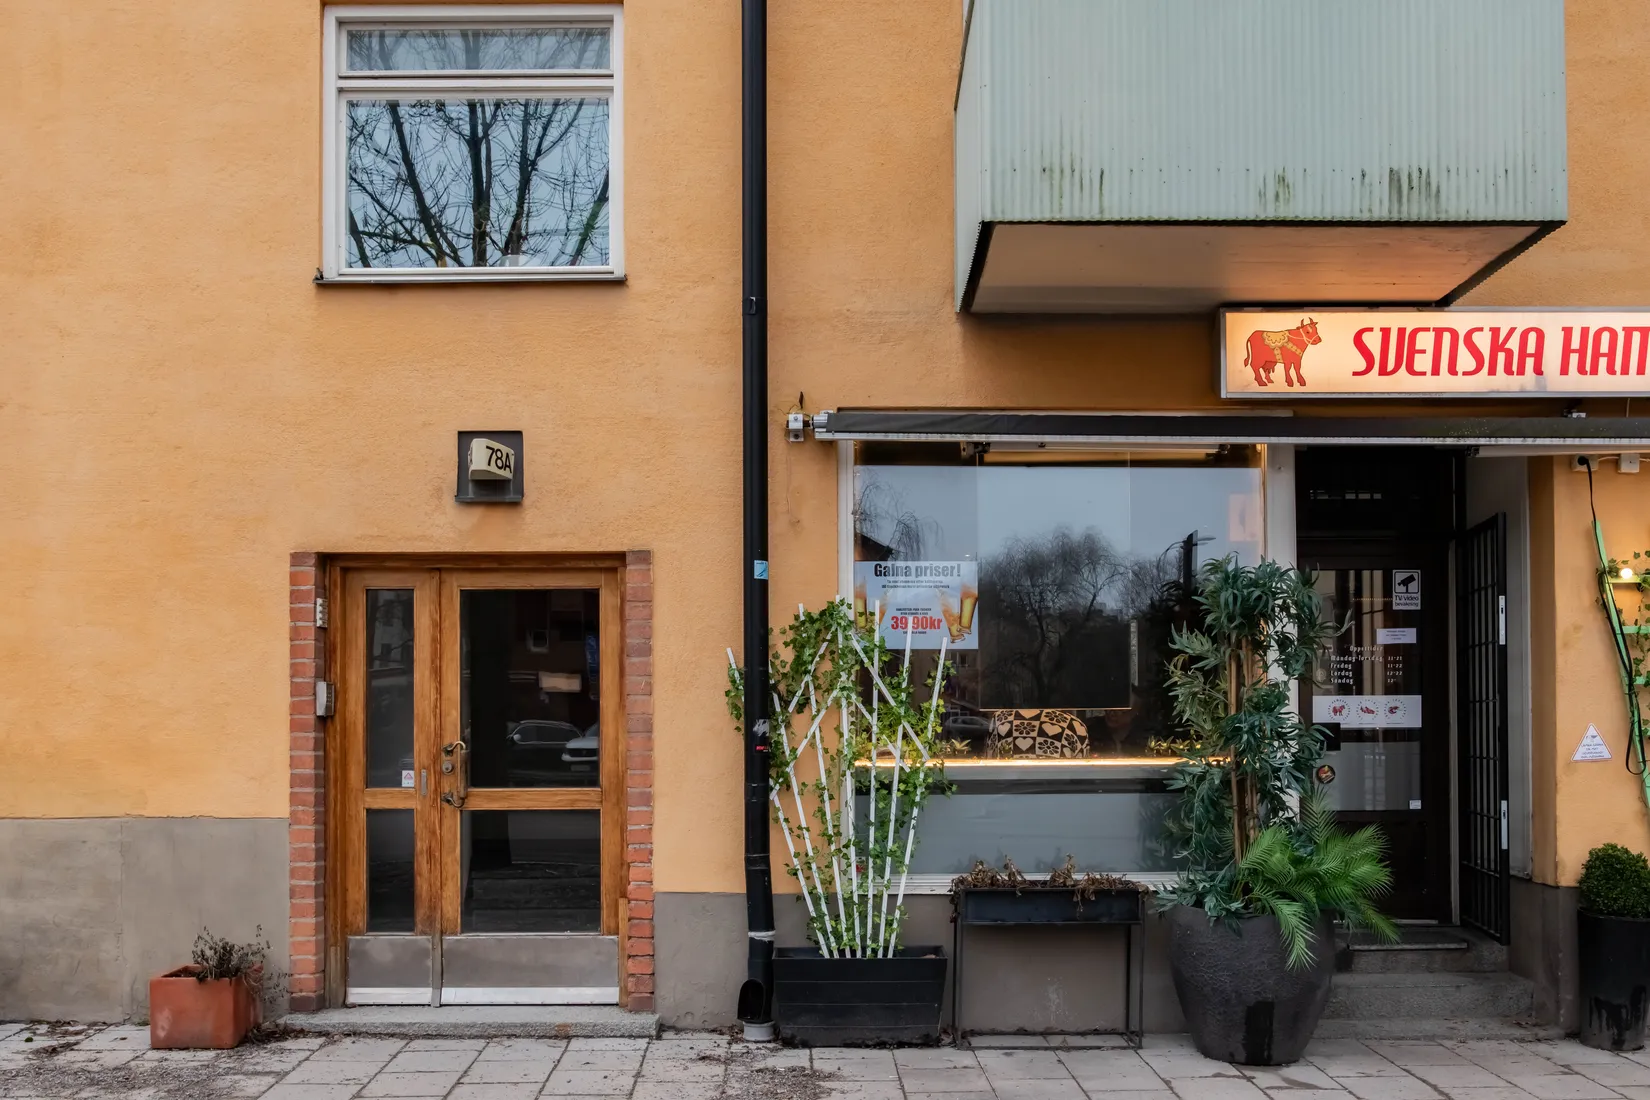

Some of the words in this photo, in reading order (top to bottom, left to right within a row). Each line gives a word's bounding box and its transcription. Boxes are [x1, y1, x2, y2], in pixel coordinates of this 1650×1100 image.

[1351, 326, 1546, 377] SVENSKA
[485, 445, 513, 474] 78A
[914, 563, 962, 579] priser!
[890, 616, 943, 630] 3990kr
